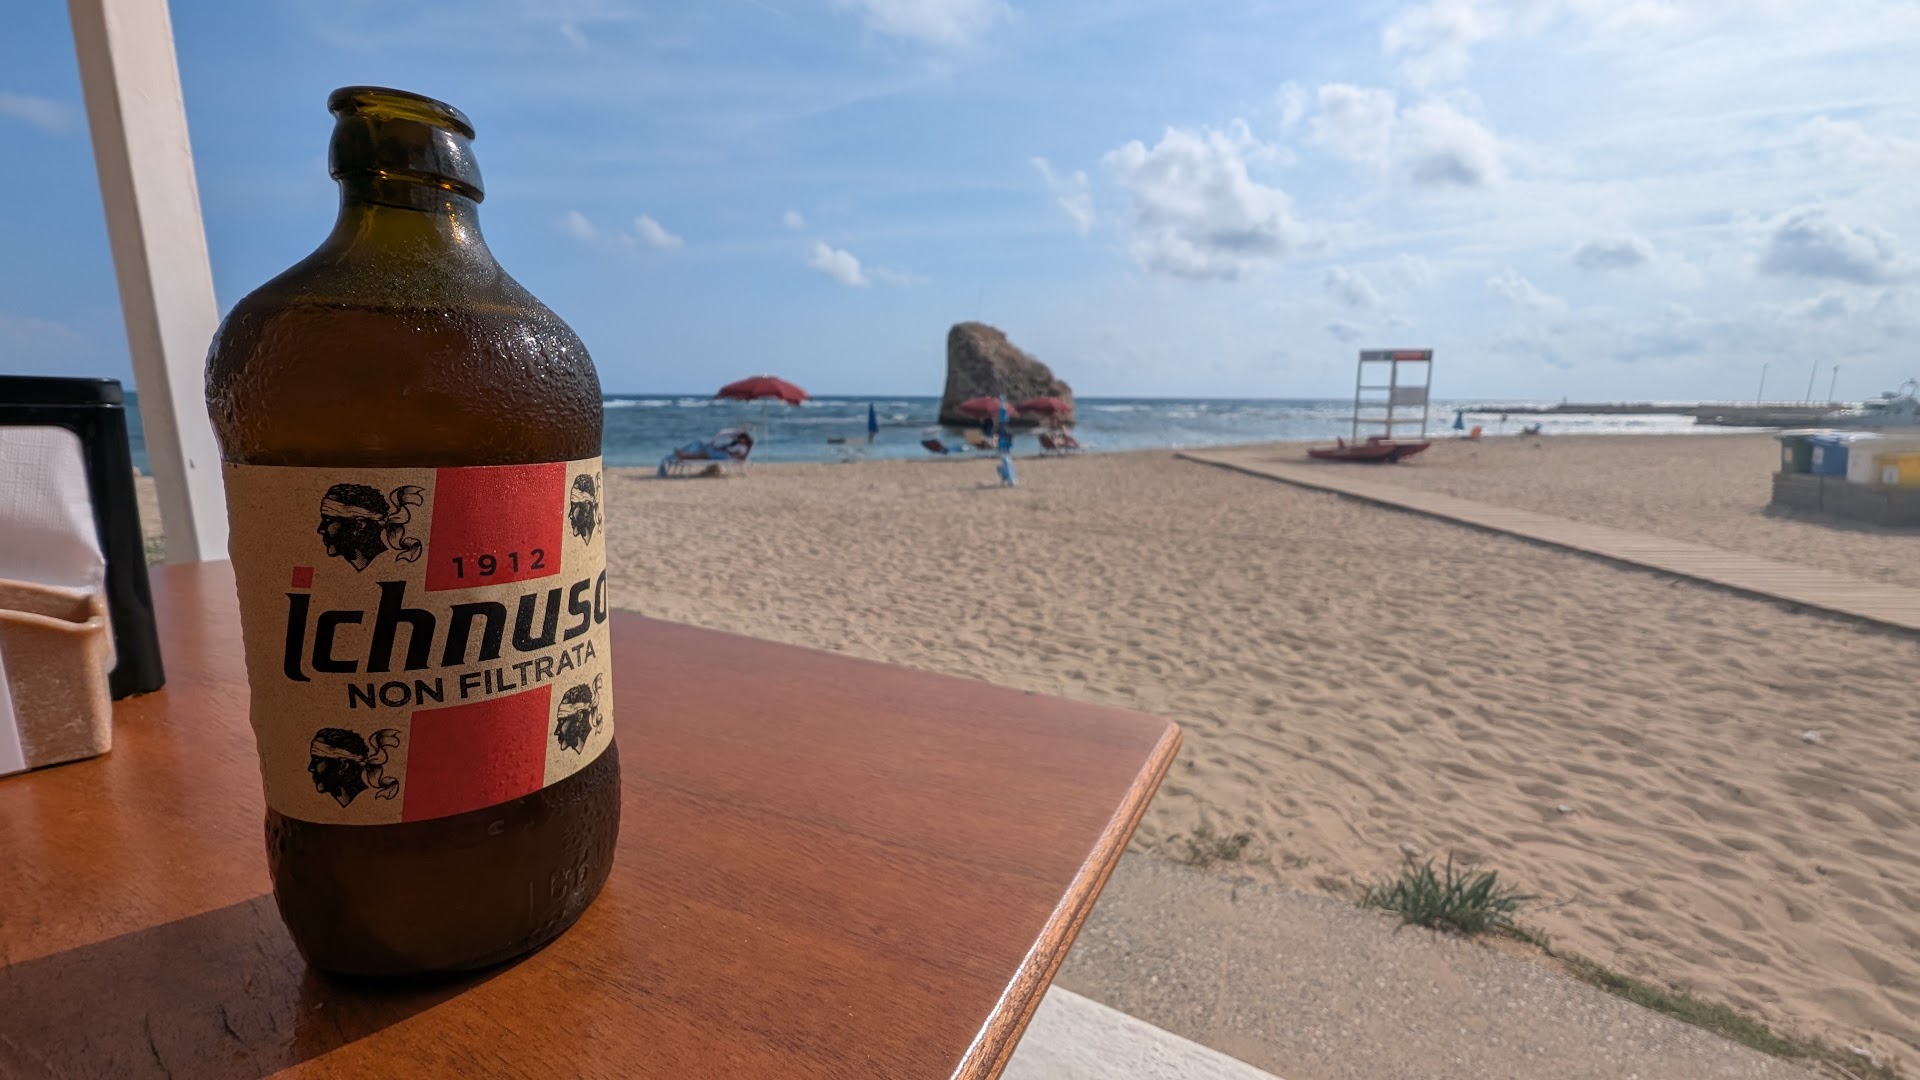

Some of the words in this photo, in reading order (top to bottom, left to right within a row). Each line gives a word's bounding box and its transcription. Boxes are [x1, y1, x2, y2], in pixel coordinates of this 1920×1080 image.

[452, 548, 545, 579] 1912
[348, 678, 445, 709] NON
[460, 639, 597, 699] FILTRATA
